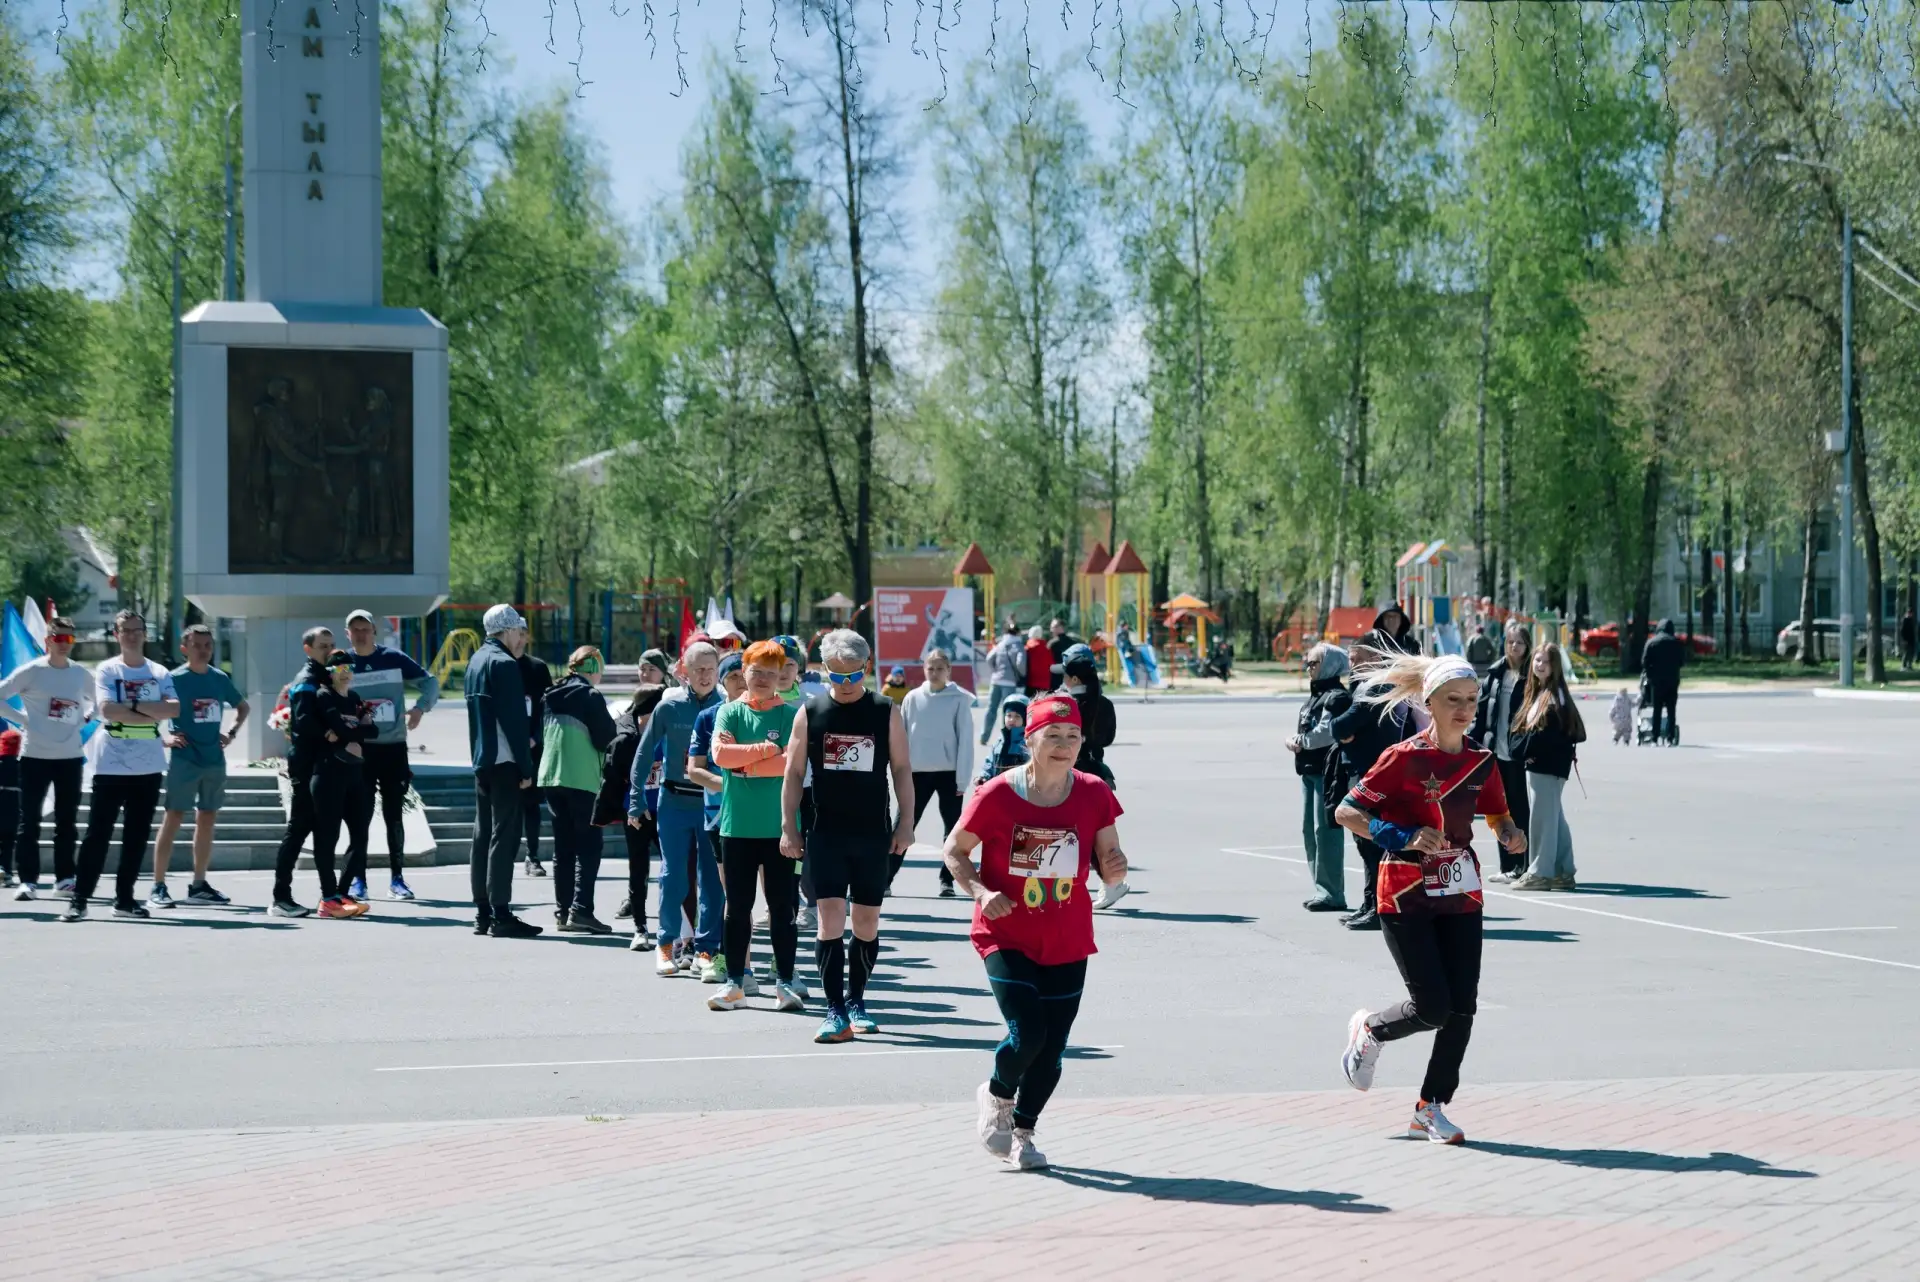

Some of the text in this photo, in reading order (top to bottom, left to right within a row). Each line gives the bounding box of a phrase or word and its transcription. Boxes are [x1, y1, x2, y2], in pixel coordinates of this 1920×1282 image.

[302, 3, 326, 201] АМ ТЫЛА
[836, 744, 860, 763] 23
[1028, 843, 1061, 867] 47
[1438, 861, 1463, 885] 08
